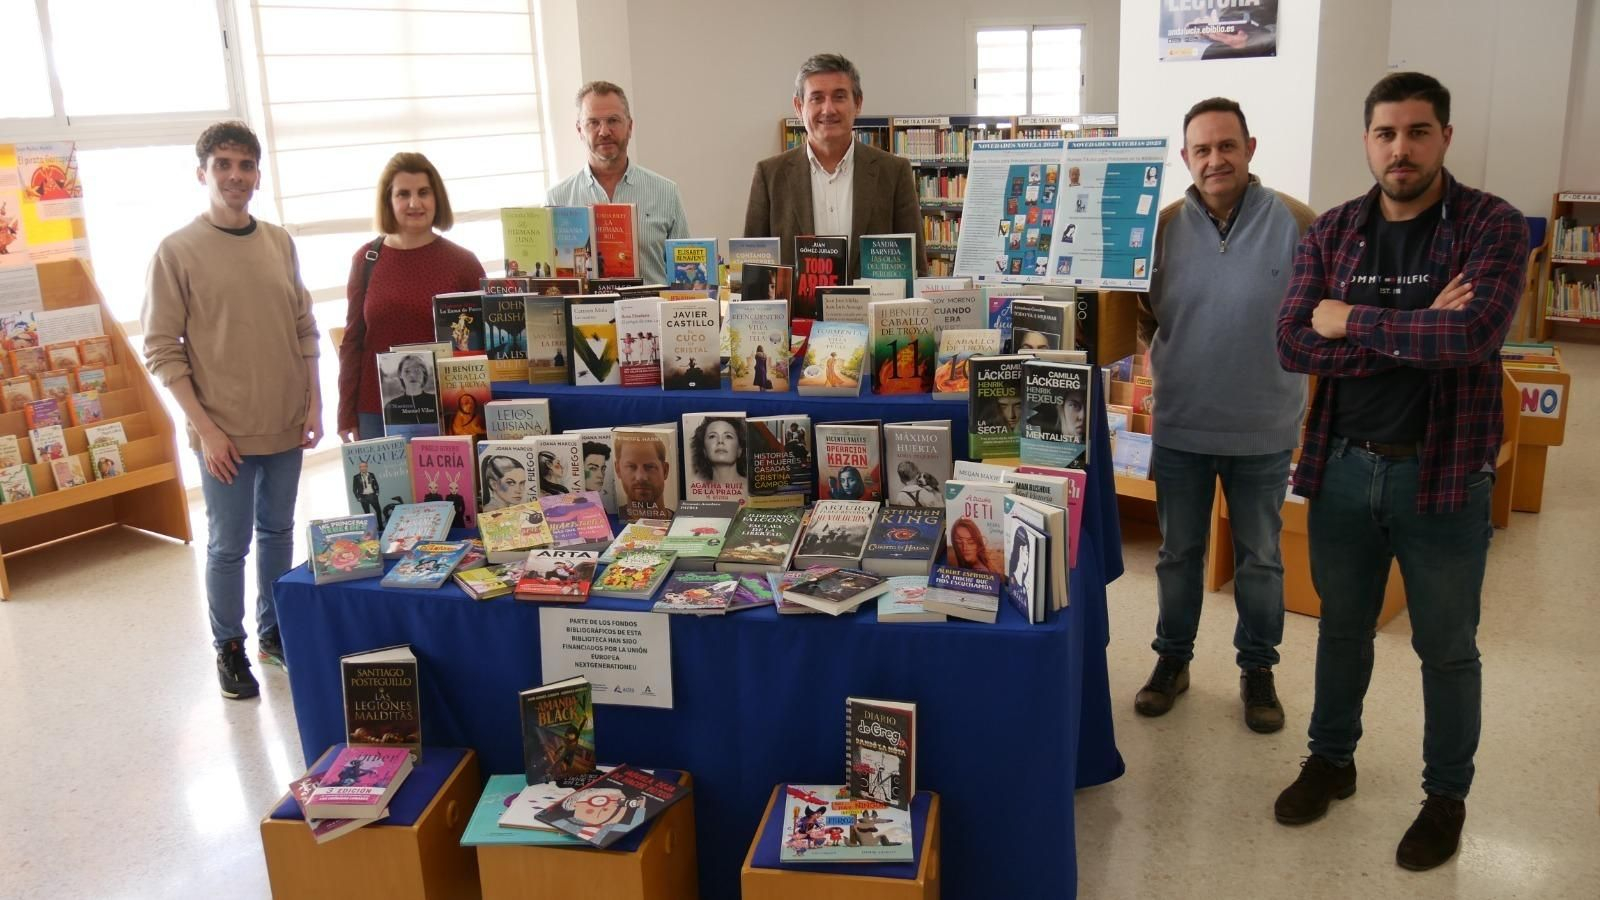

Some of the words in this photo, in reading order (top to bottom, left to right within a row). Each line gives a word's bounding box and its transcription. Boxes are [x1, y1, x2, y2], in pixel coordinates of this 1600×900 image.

[870, 248, 902, 256] BARNEDA
[804, 257, 834, 274] TODO
[1397, 274, 1430, 284] HILFIG
[484, 286, 524, 294] LICENCIA
[498, 300, 525, 310] JOHN
[889, 307, 928, 318] BENÍTEZ
[934, 307, 972, 315] CUANDO
[488, 312, 526, 323] GRISHA
[880, 317, 929, 327] CABALLO
[881, 327, 894, 336] DE
[899, 326, 929, 336] TROYA
[452, 364, 485, 373] BENÍTEZ
[1000, 364, 1022, 372] CAMIL
[978, 369, 1022, 380] LÄCKBER
[1048, 371, 1080, 380] CAMILLA
[460, 381, 486, 389] TROYA
[1026, 374, 1080, 390] LÄCKBERG
[978, 388, 1016, 397] FEXEUS
[1026, 386, 1052, 394] HENRIK
[1026, 394, 1064, 405] FEXEUS
[1520, 388, 1558, 414] NO
[492, 420, 542, 432] LUISIANA
[978, 426, 1008, 434] SECTA
[1026, 431, 1080, 444] MENTALISTA
[896, 444, 937, 454] HUERTA
[420, 455, 434, 468] LA
[437, 453, 464, 468] CRÍA
[570, 446, 580, 478] FUEGO
[766, 458, 801, 466] MUJERES
[526, 452, 536, 482] FUEGO
[754, 474, 790, 482] CRISTINA
[1028, 484, 1051, 494] RUSHDIE
[632, 502, 644, 510] EN
[626, 508, 667, 518] SOMBRA
[880, 515, 939, 525] KING
[936, 568, 960, 576] ALBERT
[950, 579, 992, 590] ESCUCHAMOS
[566, 626, 616, 635] BIBLIOGRÁFICOS
[572, 636, 607, 644] BIBLIOTECA
[562, 644, 604, 652] FINANCIADOS
[627, 646, 648, 654] UNIÓN
[574, 662, 637, 670] NEXTGENERATIONEU
[356, 668, 404, 677] SANTIAGO
[350, 678, 412, 686] POSTEGUILLO
[354, 702, 412, 711] LEGIONES
[354, 712, 414, 720] MALDITAS
[538, 706, 579, 726] BLACK
[864, 710, 896, 725] DIARIO
[858, 719, 871, 734] de
[870, 722, 900, 746] Greg
